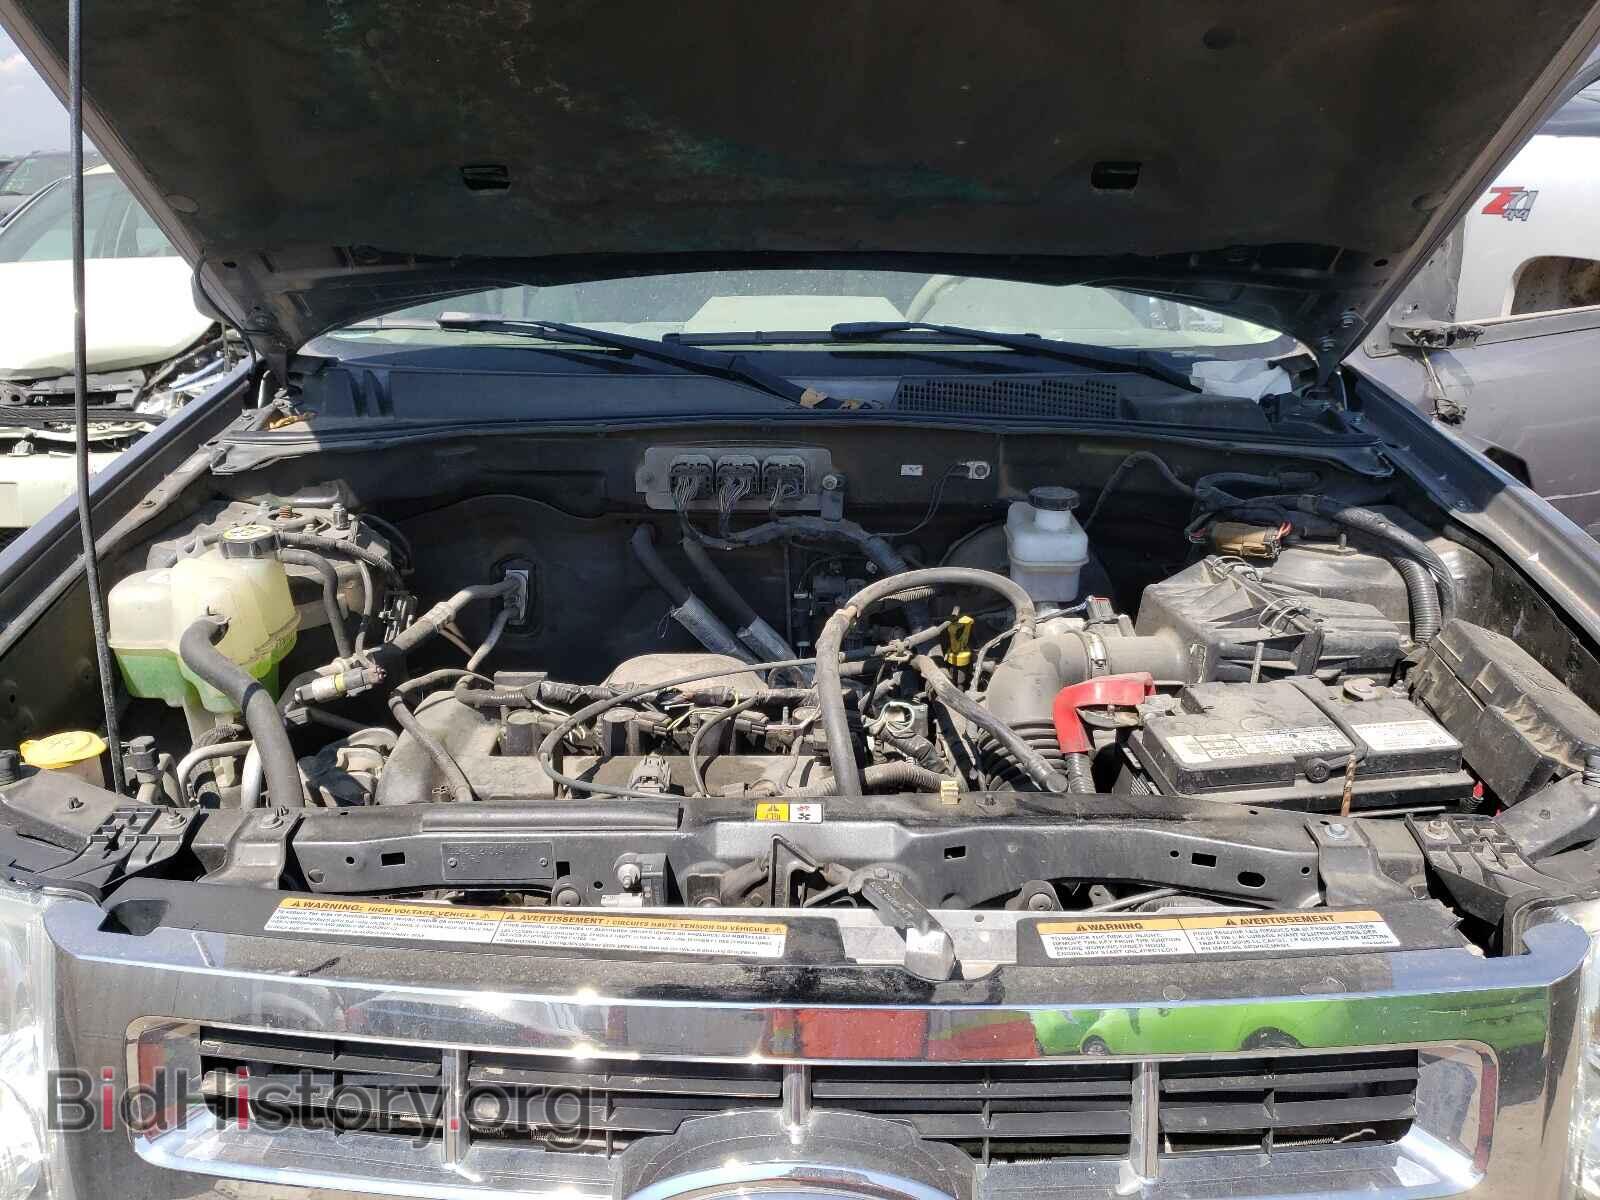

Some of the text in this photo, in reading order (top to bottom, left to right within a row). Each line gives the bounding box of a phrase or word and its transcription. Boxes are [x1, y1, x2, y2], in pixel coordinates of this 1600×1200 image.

[1481, 186, 1539, 214] Z71
[301, 901, 363, 911] WARNING:
[393, 908, 434, 916] VOLTAGE
[519, 915, 604, 924] AVERTISSEMENT
[1240, 914, 1334, 925] AVERTISSEMENT
[1088, 922, 1143, 931] WARNING
